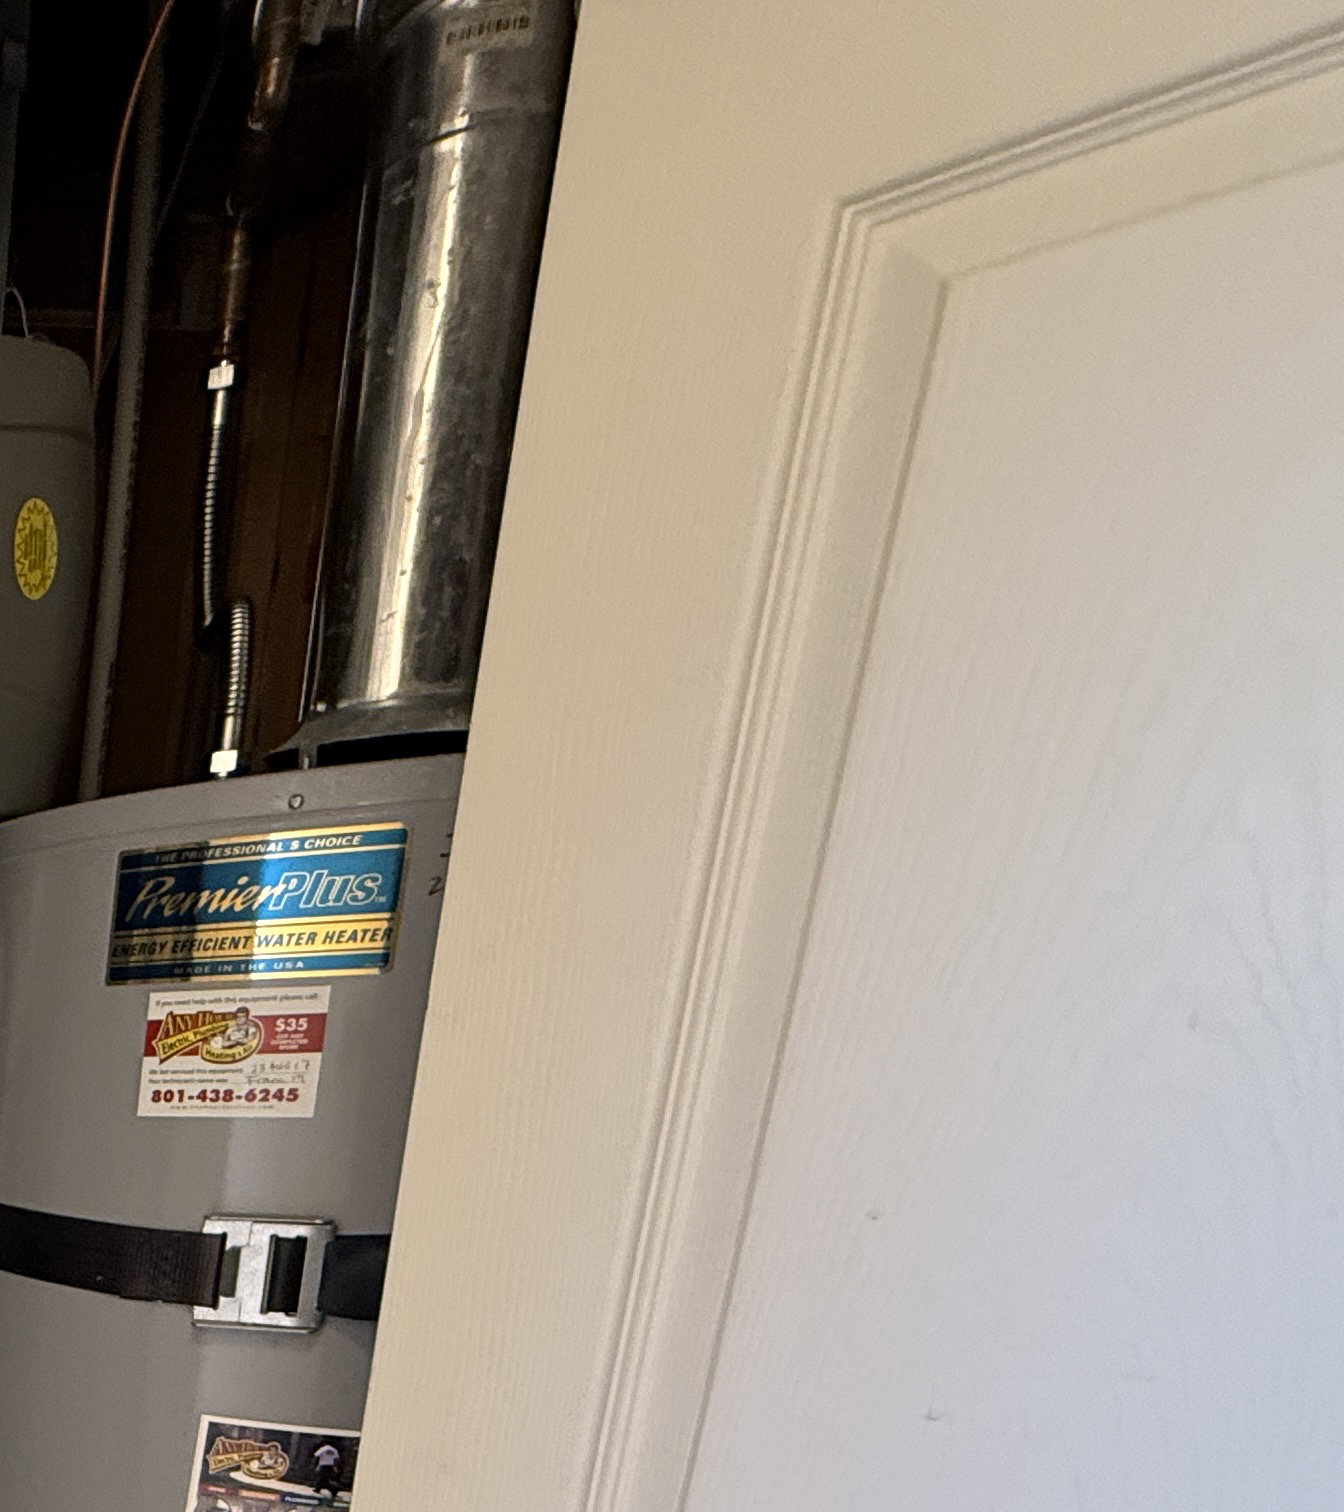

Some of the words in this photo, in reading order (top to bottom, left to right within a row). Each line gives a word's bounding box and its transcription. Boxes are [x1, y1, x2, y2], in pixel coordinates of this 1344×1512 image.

[304, 834, 362, 849] CHOICE
[113, 941, 167, 957] ENERGY
[170, 935, 253, 954] EFFICIENT
[256, 931, 318, 948] WATER
[323, 926, 393, 945] HEATER
[173, 963, 211, 976] MADE
[217, 963, 232, 973] IN
[239, 961, 266, 972] THE
[273, 960, 305, 971] USA
[280, 993, 302, 1001] please
[275, 1018, 308, 1032] $35
[205, 1046, 236, 1059] Heating
[151, 1088, 300, 1103] 801-438-6245
